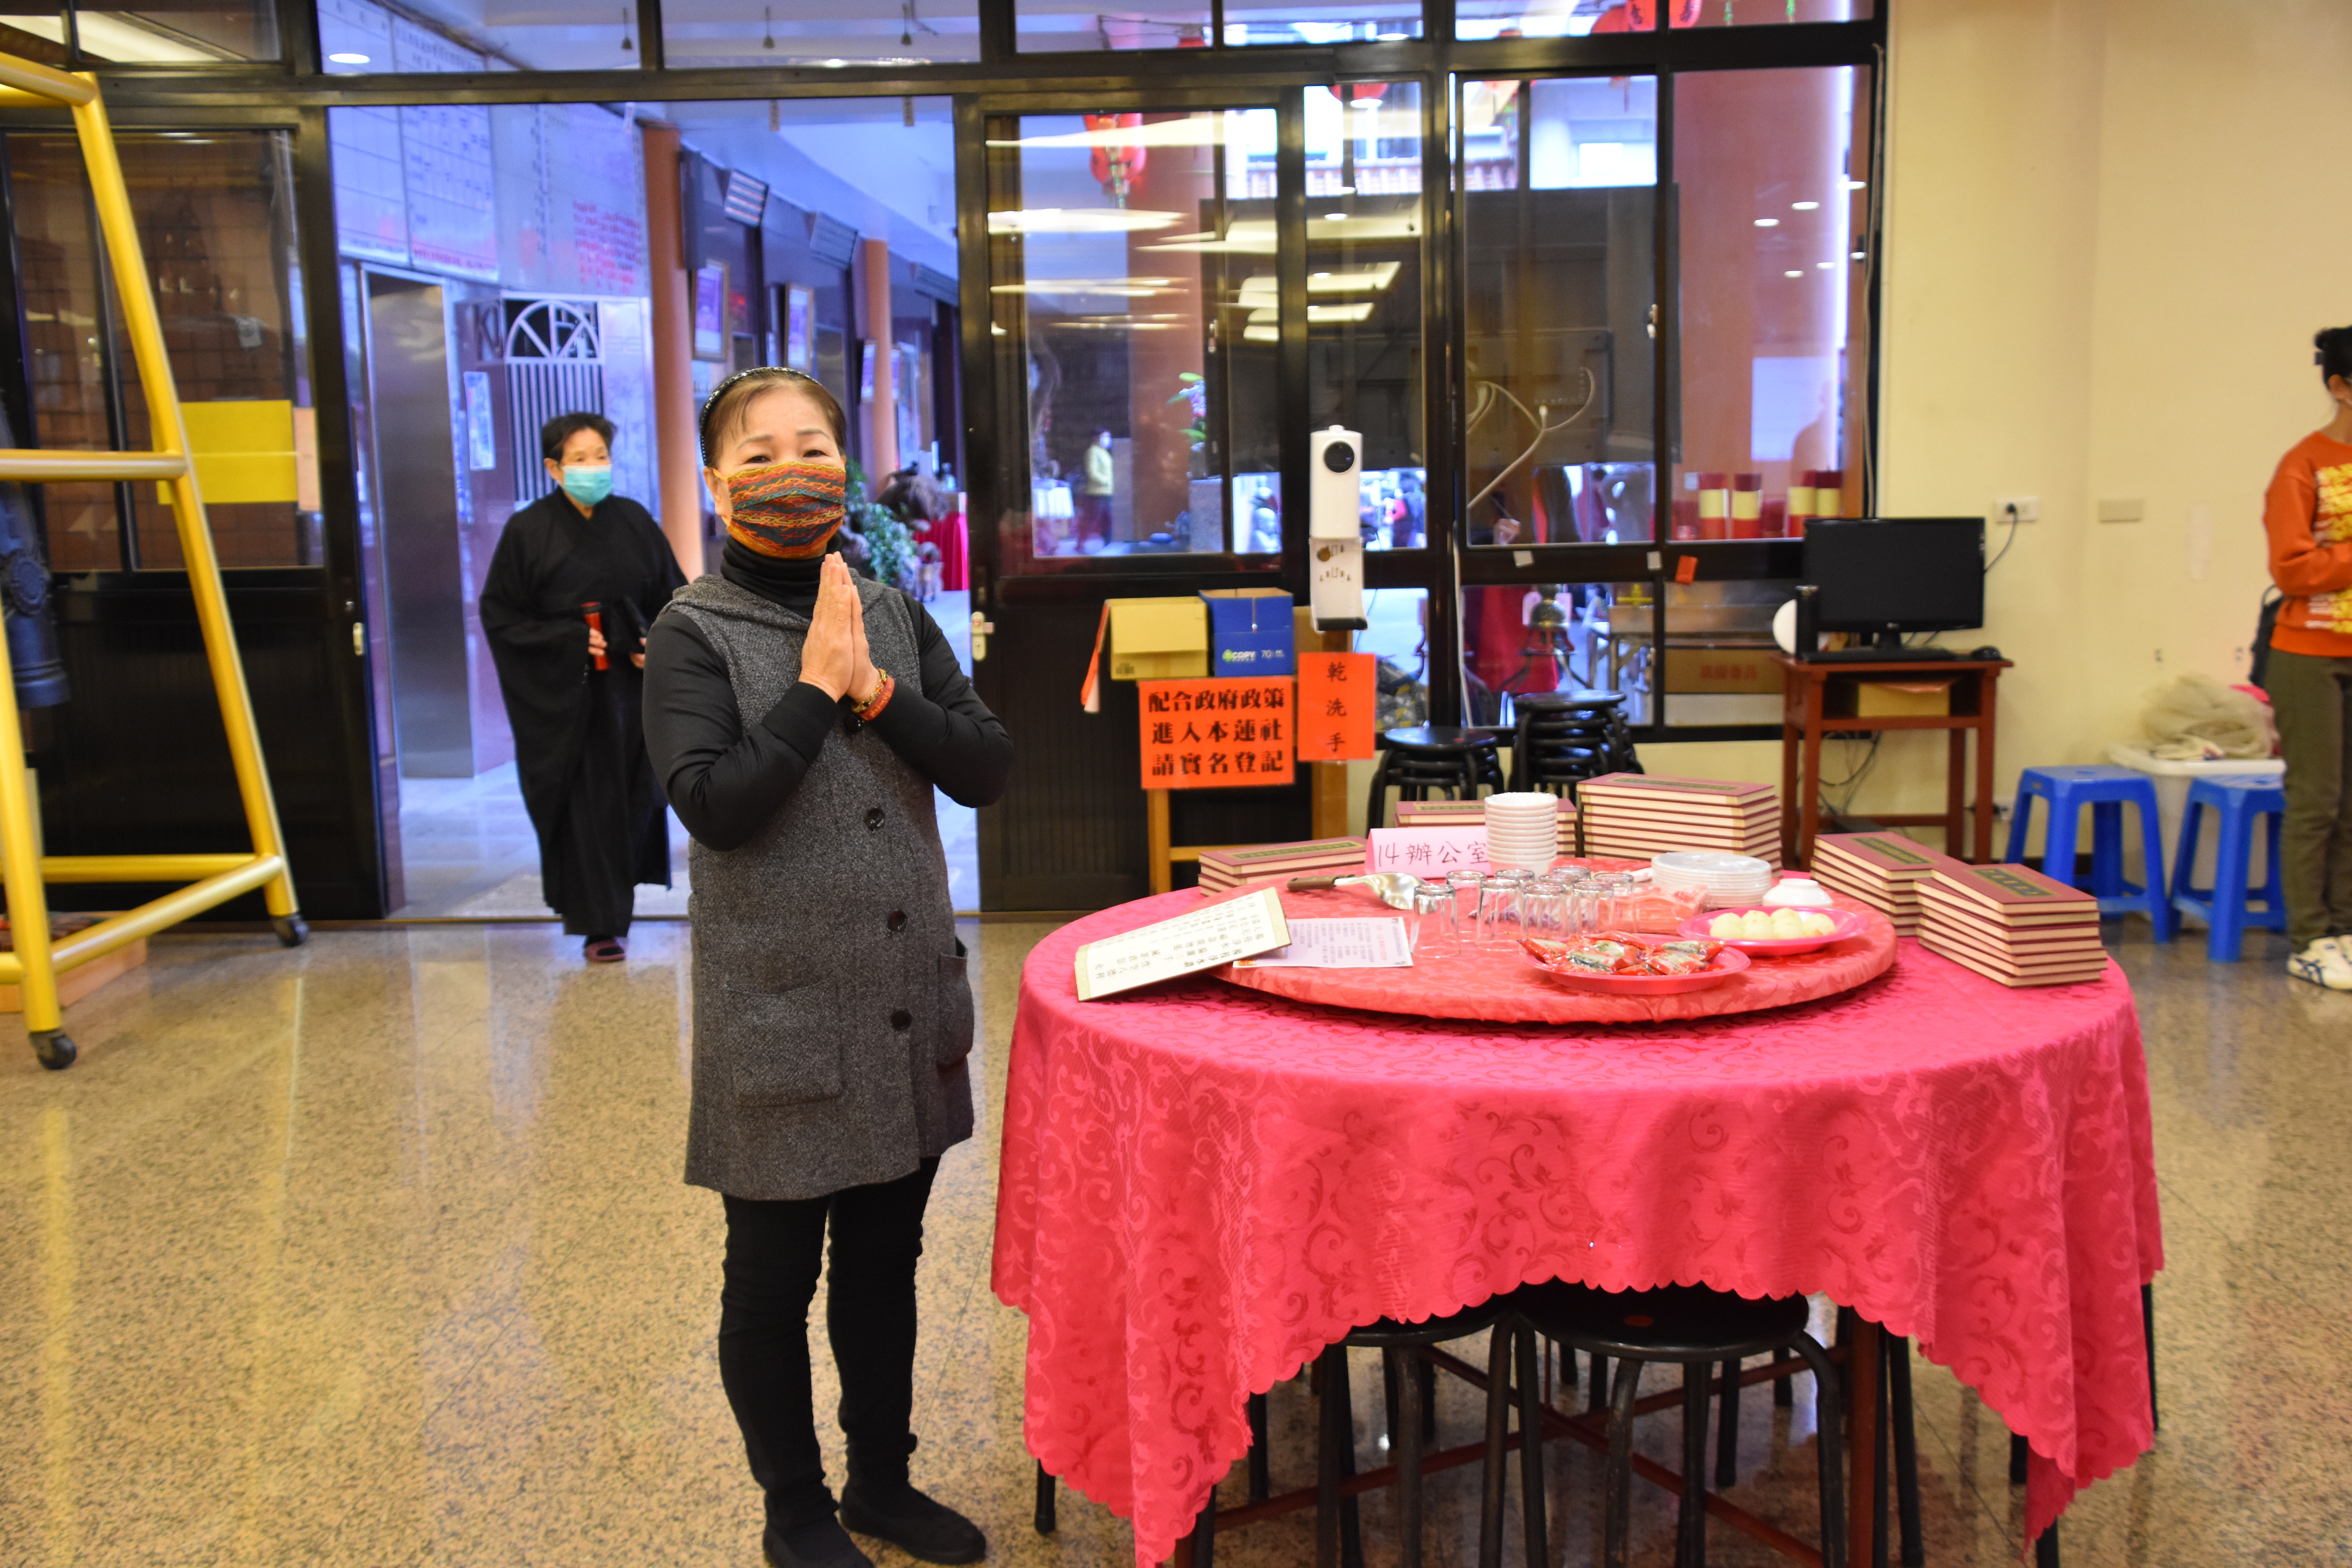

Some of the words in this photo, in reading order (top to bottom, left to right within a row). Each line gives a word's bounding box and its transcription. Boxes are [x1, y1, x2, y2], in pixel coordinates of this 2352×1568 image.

[1148, 688, 1284, 712] 配合政府政策
[1326, 662, 1347, 752] 乾洗手
[1152, 718, 1282, 744] 進入本蓮社
[1152, 750, 1283, 775] 請實名登記
